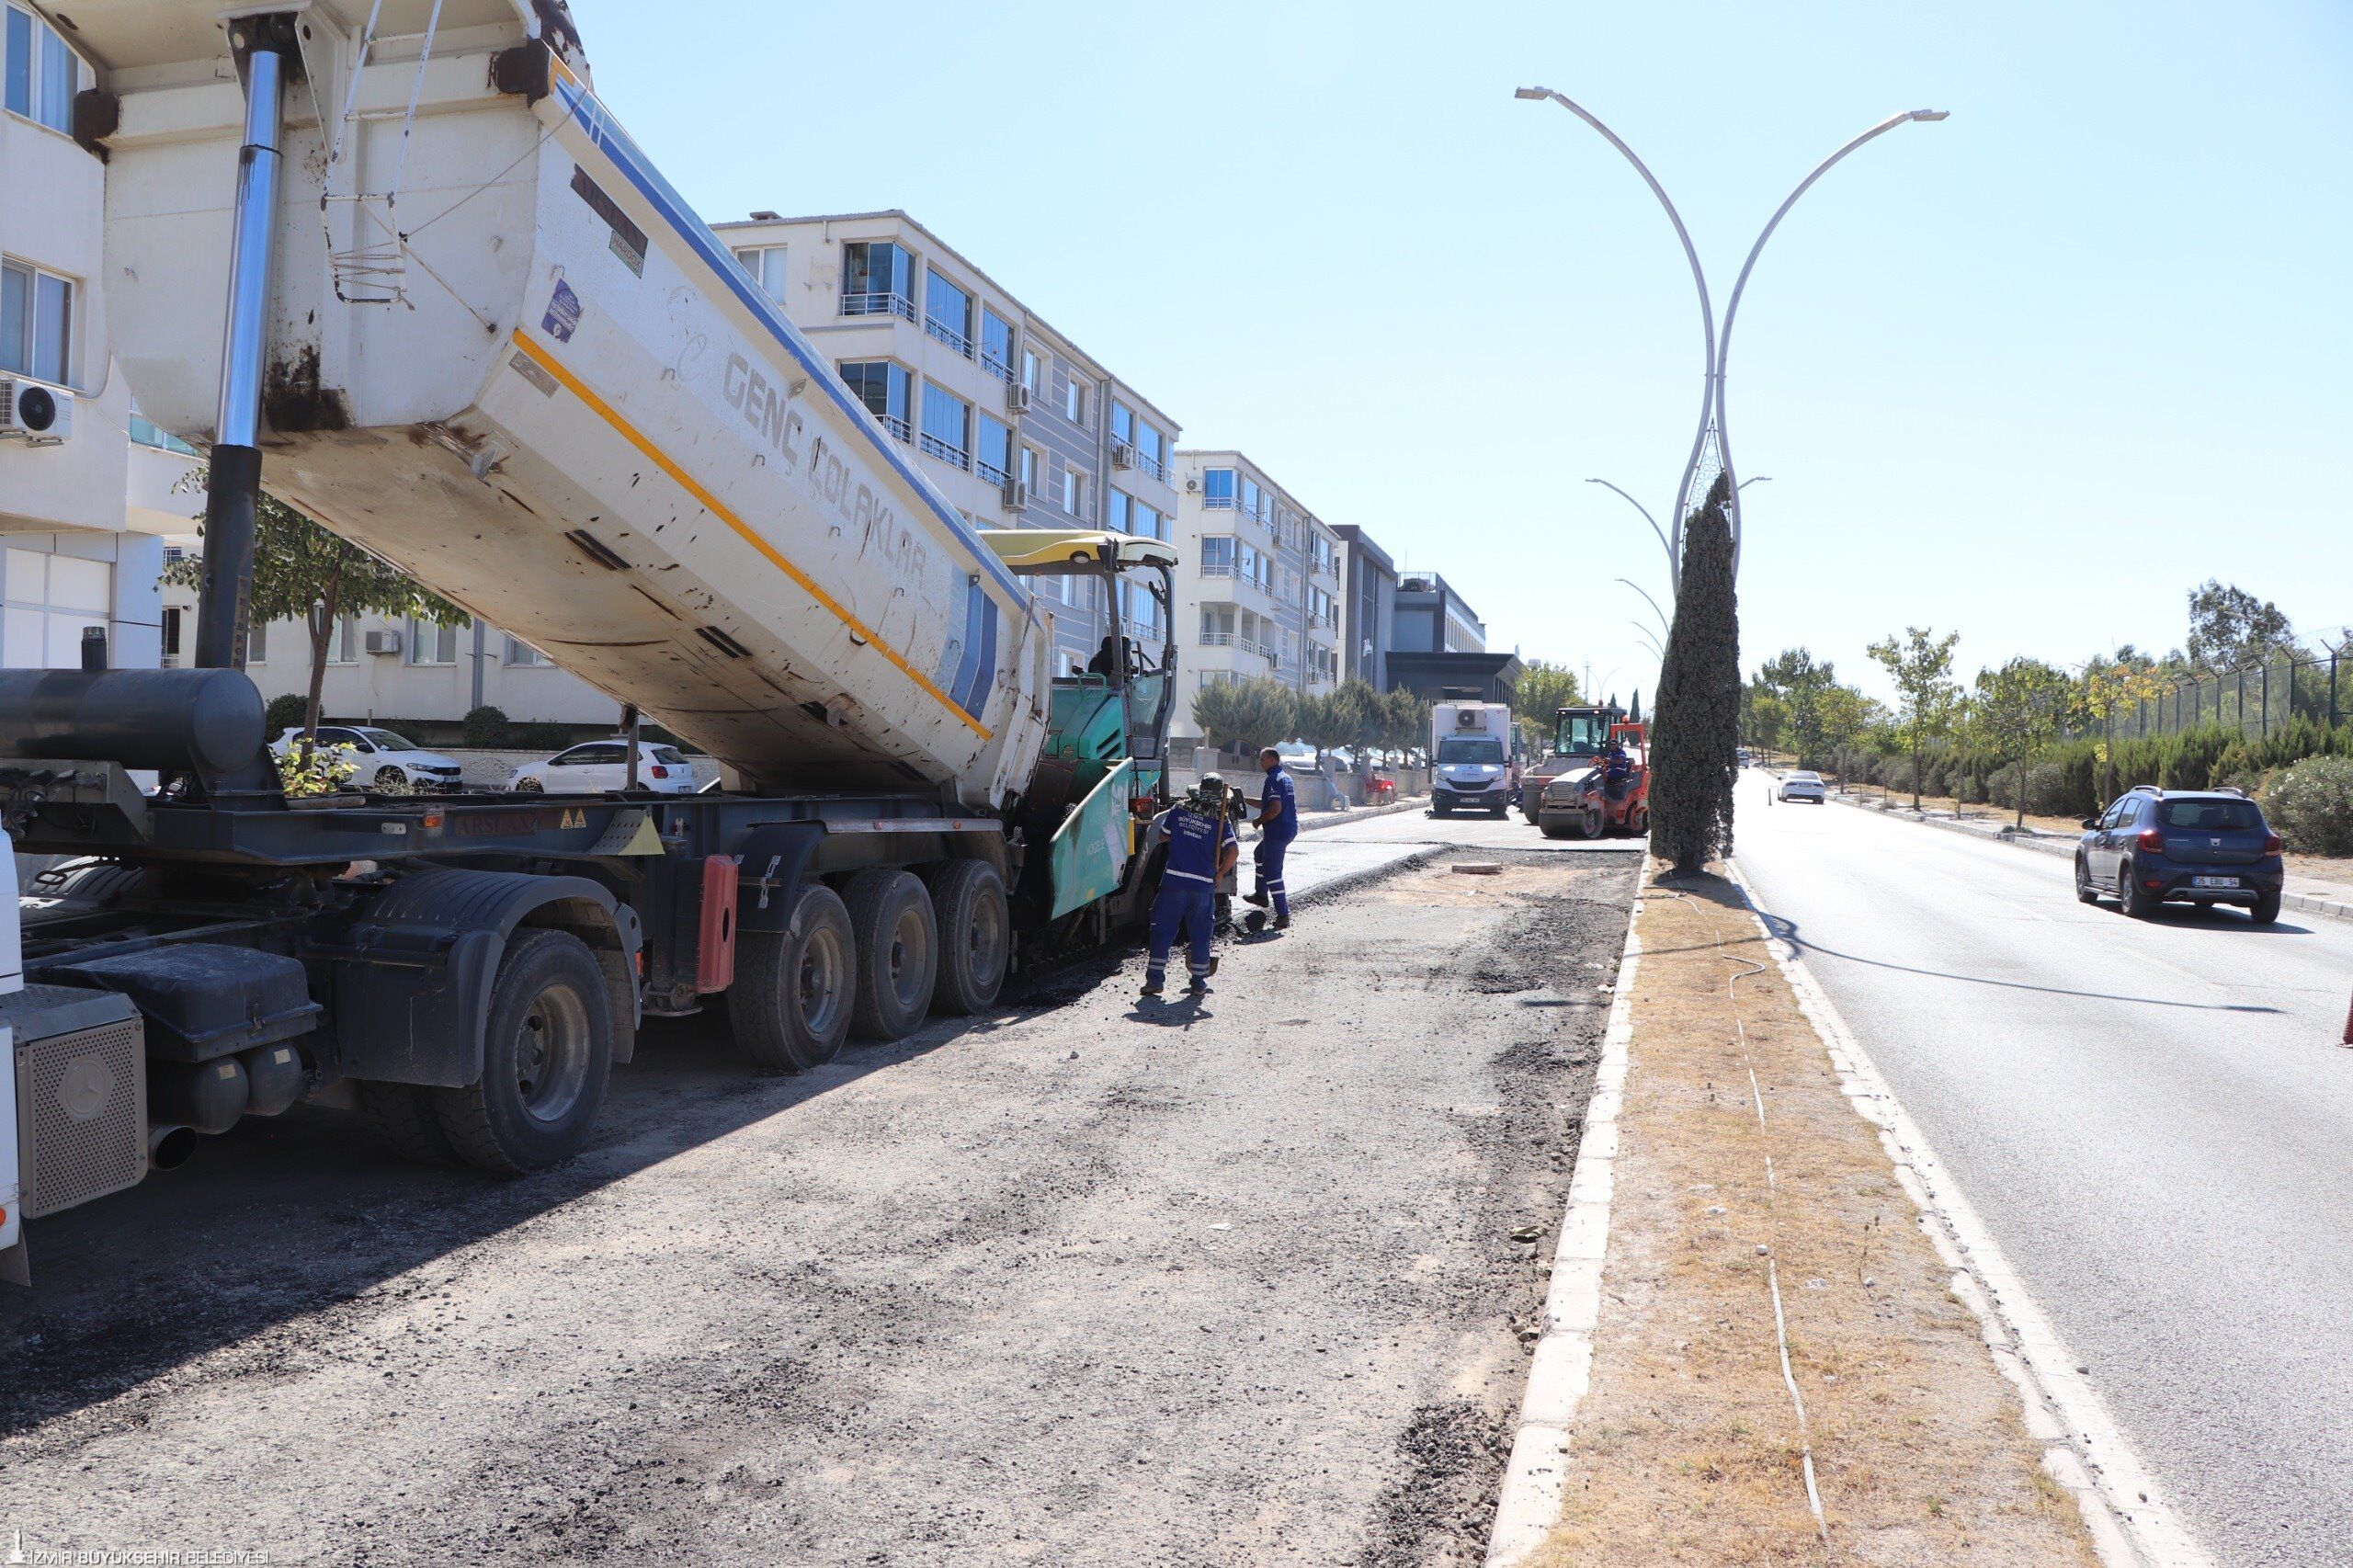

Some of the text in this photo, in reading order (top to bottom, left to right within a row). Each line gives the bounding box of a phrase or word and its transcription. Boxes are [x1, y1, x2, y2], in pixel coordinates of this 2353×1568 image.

[611, 234, 643, 275] HARDOX
[722, 352, 804, 477] GENÇ
[2197, 877, 2206, 885] 35
